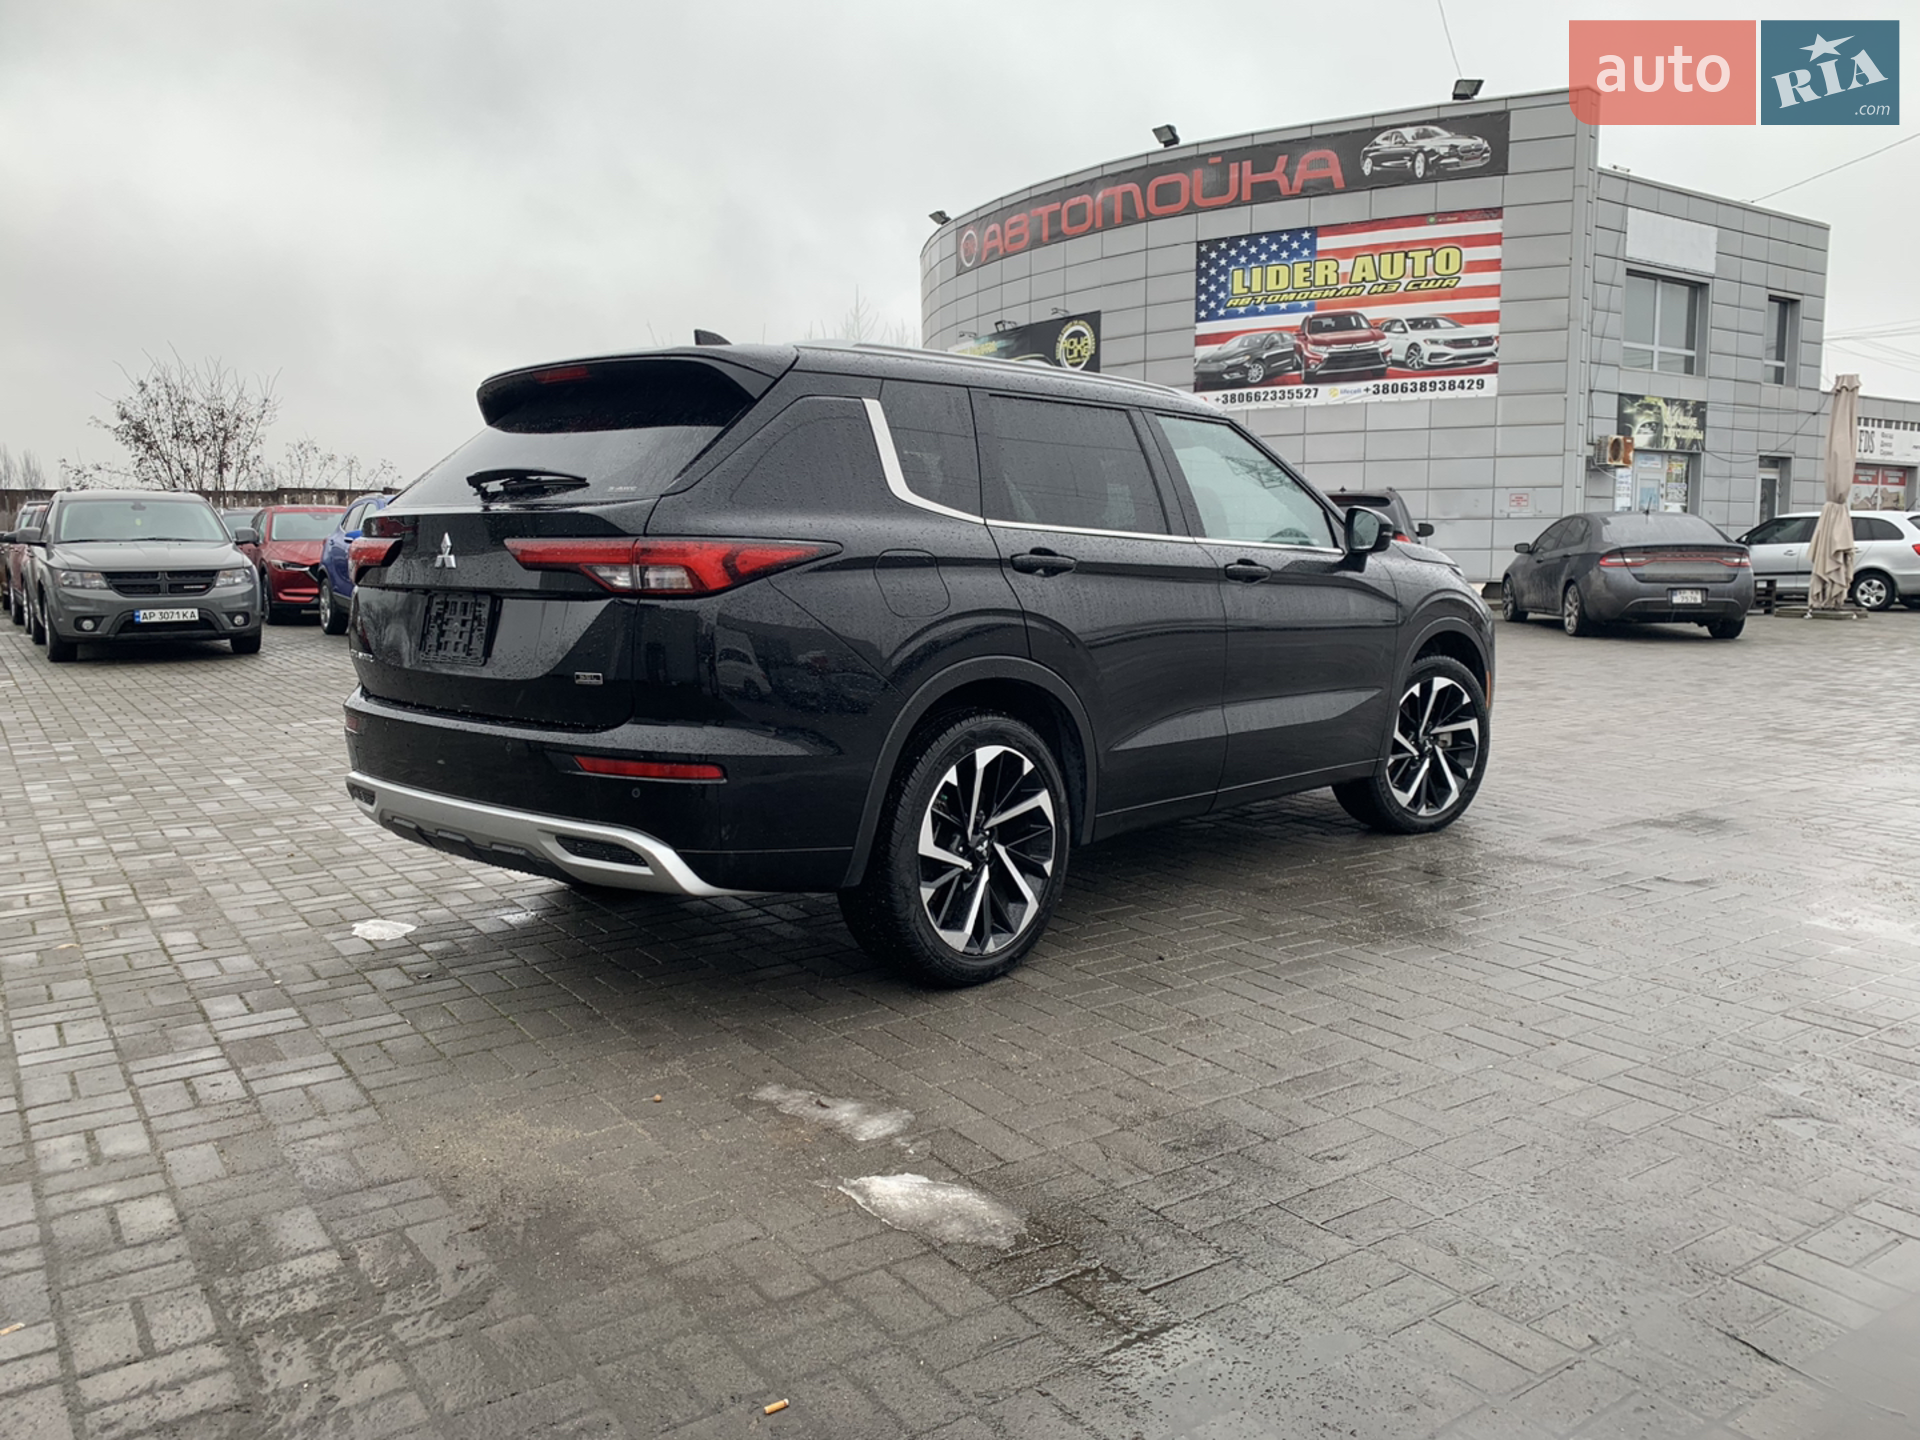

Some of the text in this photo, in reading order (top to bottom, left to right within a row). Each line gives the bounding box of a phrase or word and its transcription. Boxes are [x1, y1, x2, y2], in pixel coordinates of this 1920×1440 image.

[981, 148, 1346, 264] АВТОМОЙКА
[1230, 245, 1463, 296] LIDER AUTO
[1224, 276, 1462, 309] АВТОМОБИЛИ ИЗ США
[1214, 387, 1320, 405] +380662335527
[1363, 378, 1486, 395] +380638938429
[141, 610, 197, 621] AP 3071 KA
